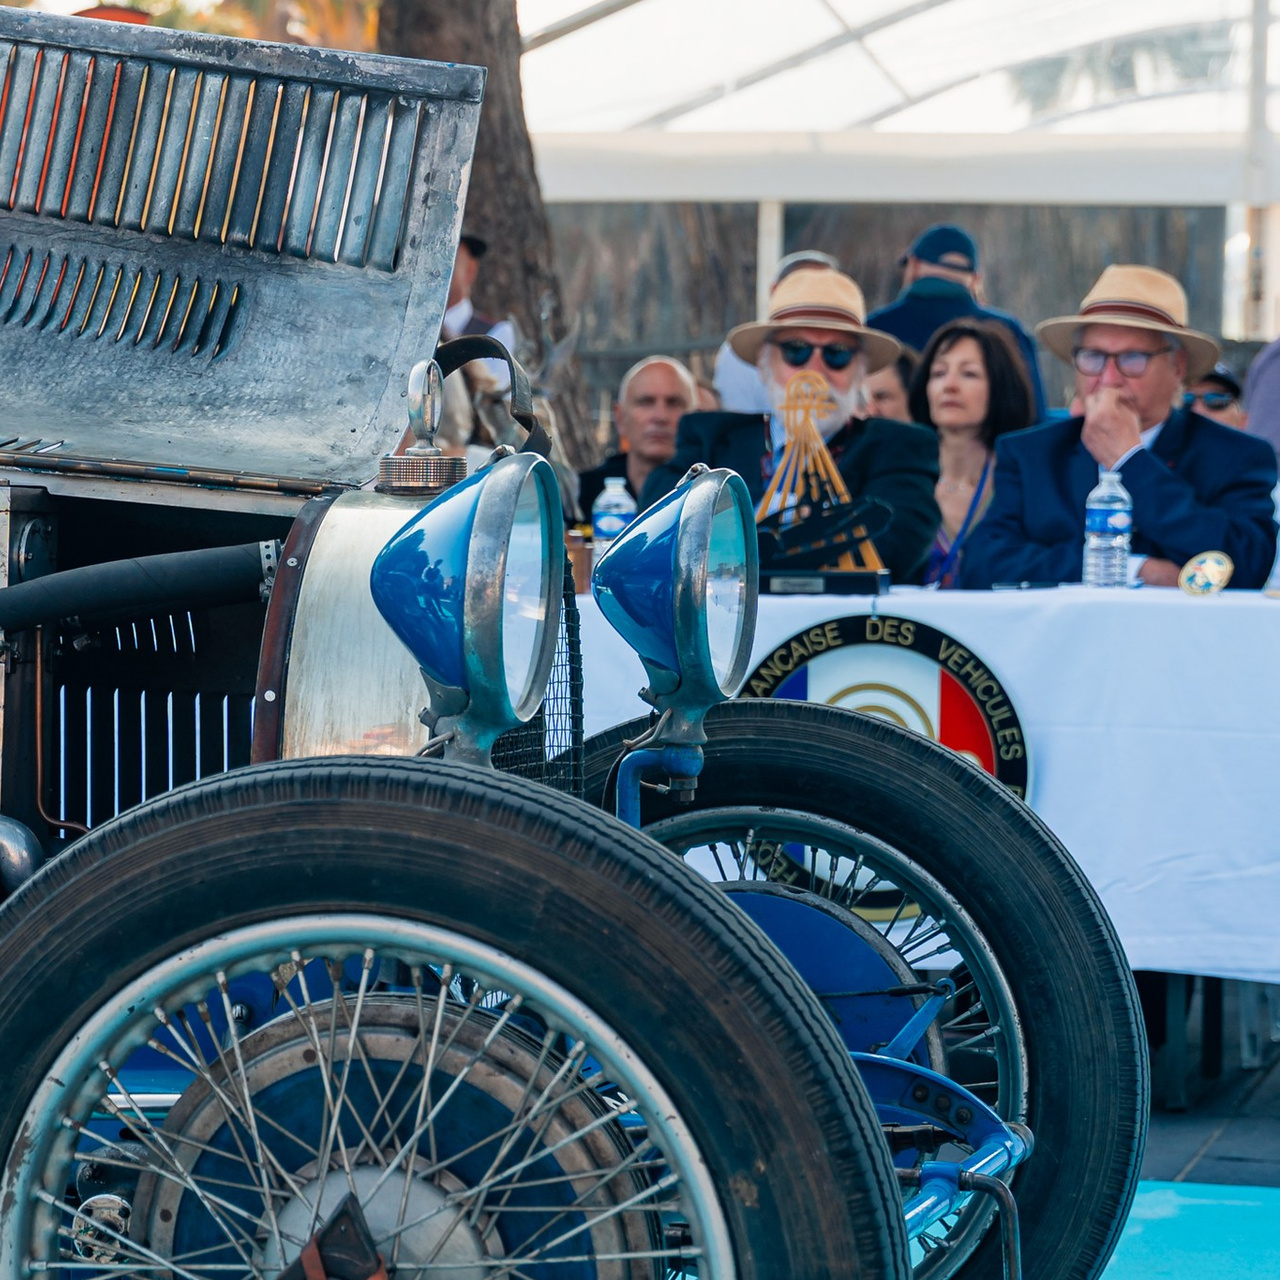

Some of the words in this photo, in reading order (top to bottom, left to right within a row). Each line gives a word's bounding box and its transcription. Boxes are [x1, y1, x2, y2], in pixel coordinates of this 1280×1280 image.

[740, 621, 843, 698] ANCAISE
[865, 618, 916, 646] DES
[938, 638, 1024, 761] VEHICULES
